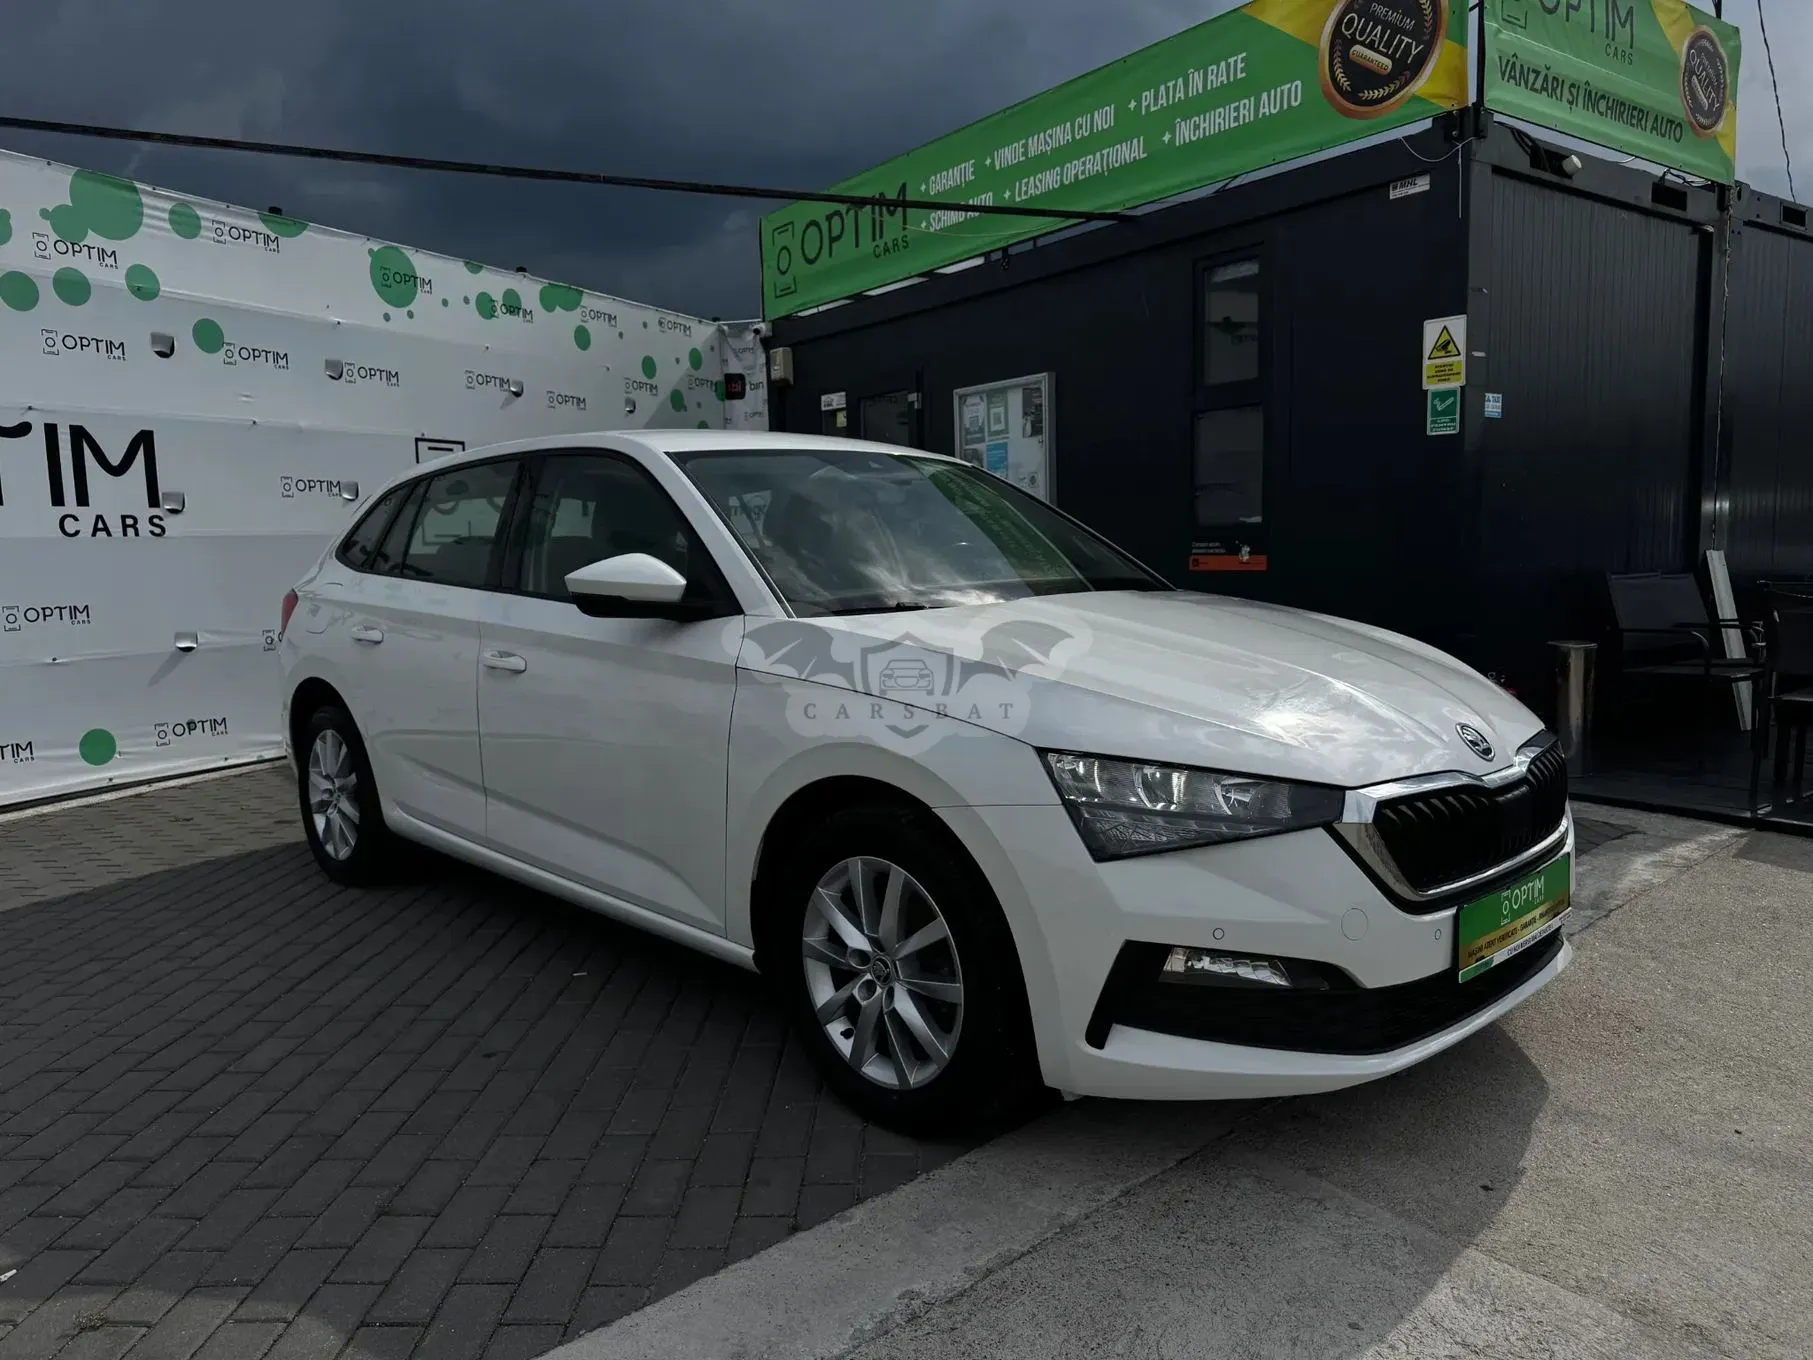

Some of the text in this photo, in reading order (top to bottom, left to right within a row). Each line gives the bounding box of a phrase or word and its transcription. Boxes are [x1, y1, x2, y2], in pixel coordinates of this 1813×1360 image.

[1341, 13, 1425, 64] QUALITY
[1351, 49, 1389, 71] GUARANTEED
[1604, 43, 1634, 66] CARS
[1141, 52, 1248, 116] PLATA ÎN RATE
[1689, 49, 1720, 112] QUALITY
[1498, 52, 1565, 101] VÂNZĂRI
[1567, 77, 1580, 113] ȘI
[1582, 80, 1650, 132] ÎNCHIRIERI
[1649, 113, 1683, 143] AUTO
[1174, 79, 1302, 147] ÎNCHIRIERI AUTO
[994, 103, 1115, 171] VINDE MAȘINA CU NOI
[929, 159, 975, 195] GARANȚIE
[1015, 135, 1148, 203] LEASING OPERAȚIONAL
[801, 182, 908, 265] OPTIM
[228, 226, 280, 249] OPTIM
[872, 235, 910, 259] CARS
[53, 239, 118, 265] OPTIM
[392, 271, 433, 291] OPTIM
[500, 303, 534, 321] OPTIM
[588, 309, 617, 325] OPTIM
[667, 321, 691, 333] OPTIM
[61, 334, 125, 357] OPTIM
[238, 346, 289, 366] OPTIM
[357, 366, 400, 384] OPTIM
[475, 373, 511, 390] OPTIM
[631, 381, 658, 396] OPTIM
[556, 393, 587, 408] OPTIM
[295, 478, 341, 493] OPTIM
[58, 513, 167, 538] CARS
[23, 604, 91, 623] OPTIM
[172, 716, 227, 737] OPTIM
[1511, 875, 1545, 910] OPTIM
